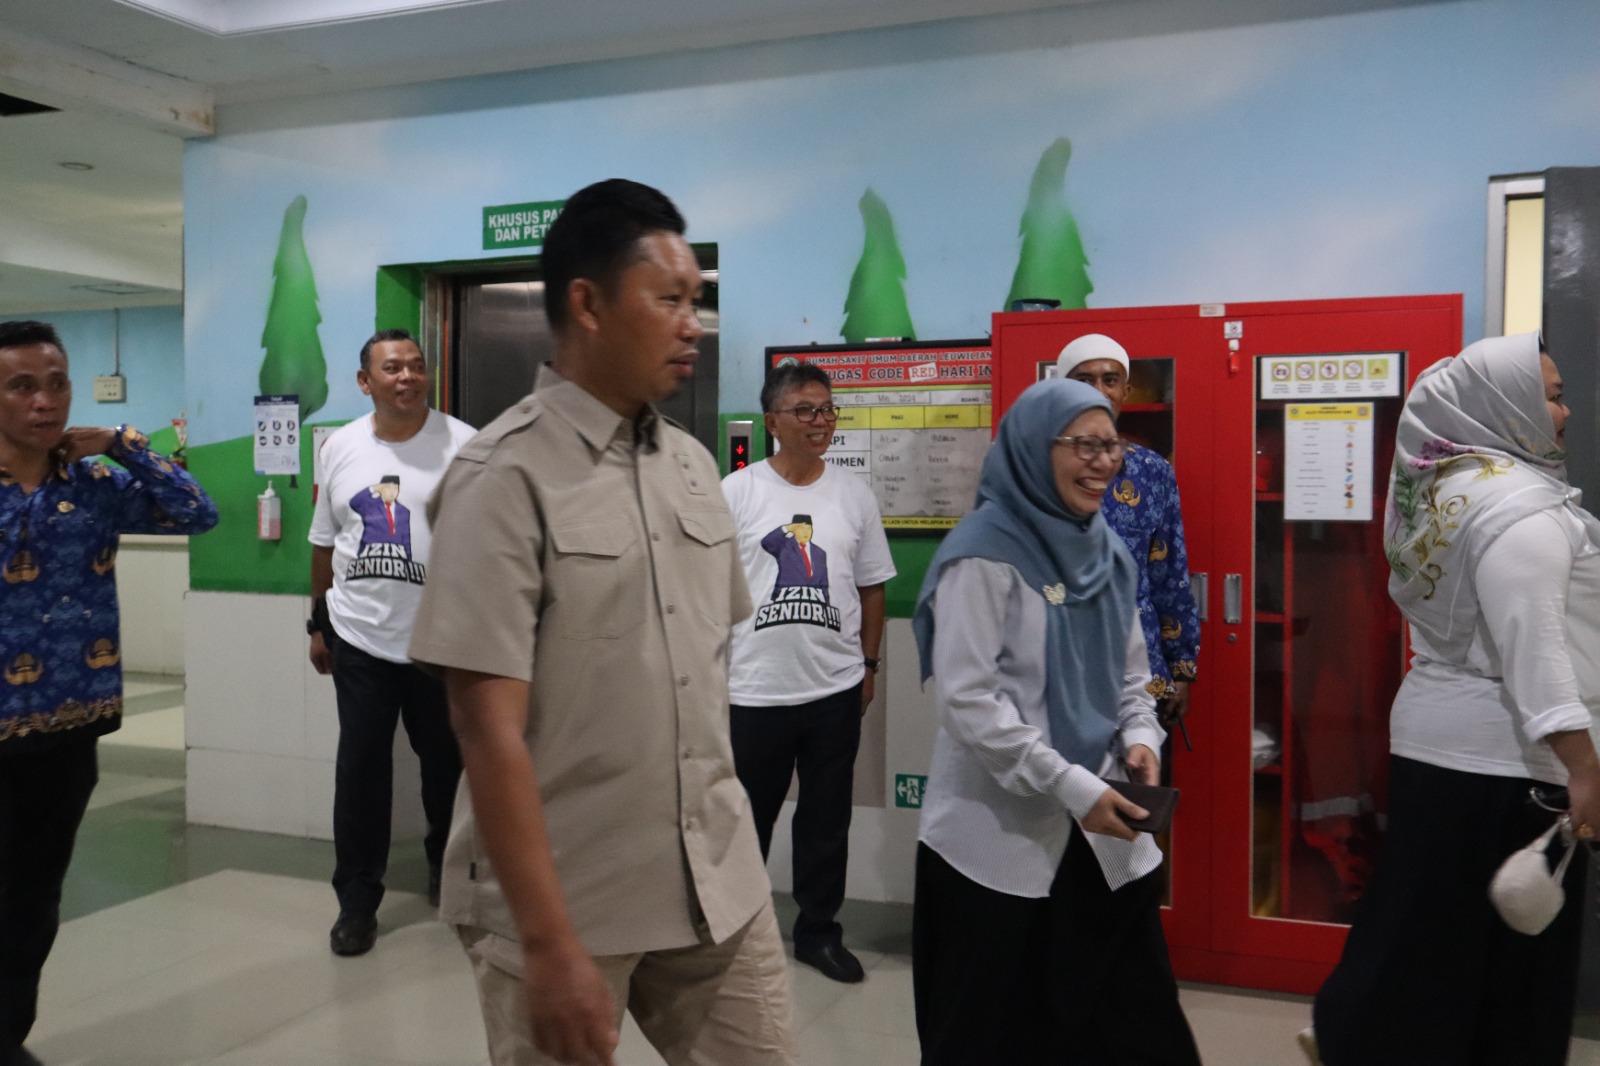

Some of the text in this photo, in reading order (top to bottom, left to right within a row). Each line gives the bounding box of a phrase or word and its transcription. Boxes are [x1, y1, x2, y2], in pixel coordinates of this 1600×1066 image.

[488, 210, 540, 229] KHUSUS
[494, 223, 551, 242] DAN PET
[805, 356, 838, 366] RUMAH
[840, 355, 867, 364] SAKIT
[869, 354, 897, 363] UMUM
[899, 353, 936, 362] DAERAH
[825, 369, 862, 380] UGAS
[868, 367, 904, 379] CODE
[911, 366, 936, 378] RED
[940, 365, 974, 377] HARI
[830, 435, 845, 446] PI
[359, 542, 408, 560] IZIN
[775, 585, 826, 603] IZIN
